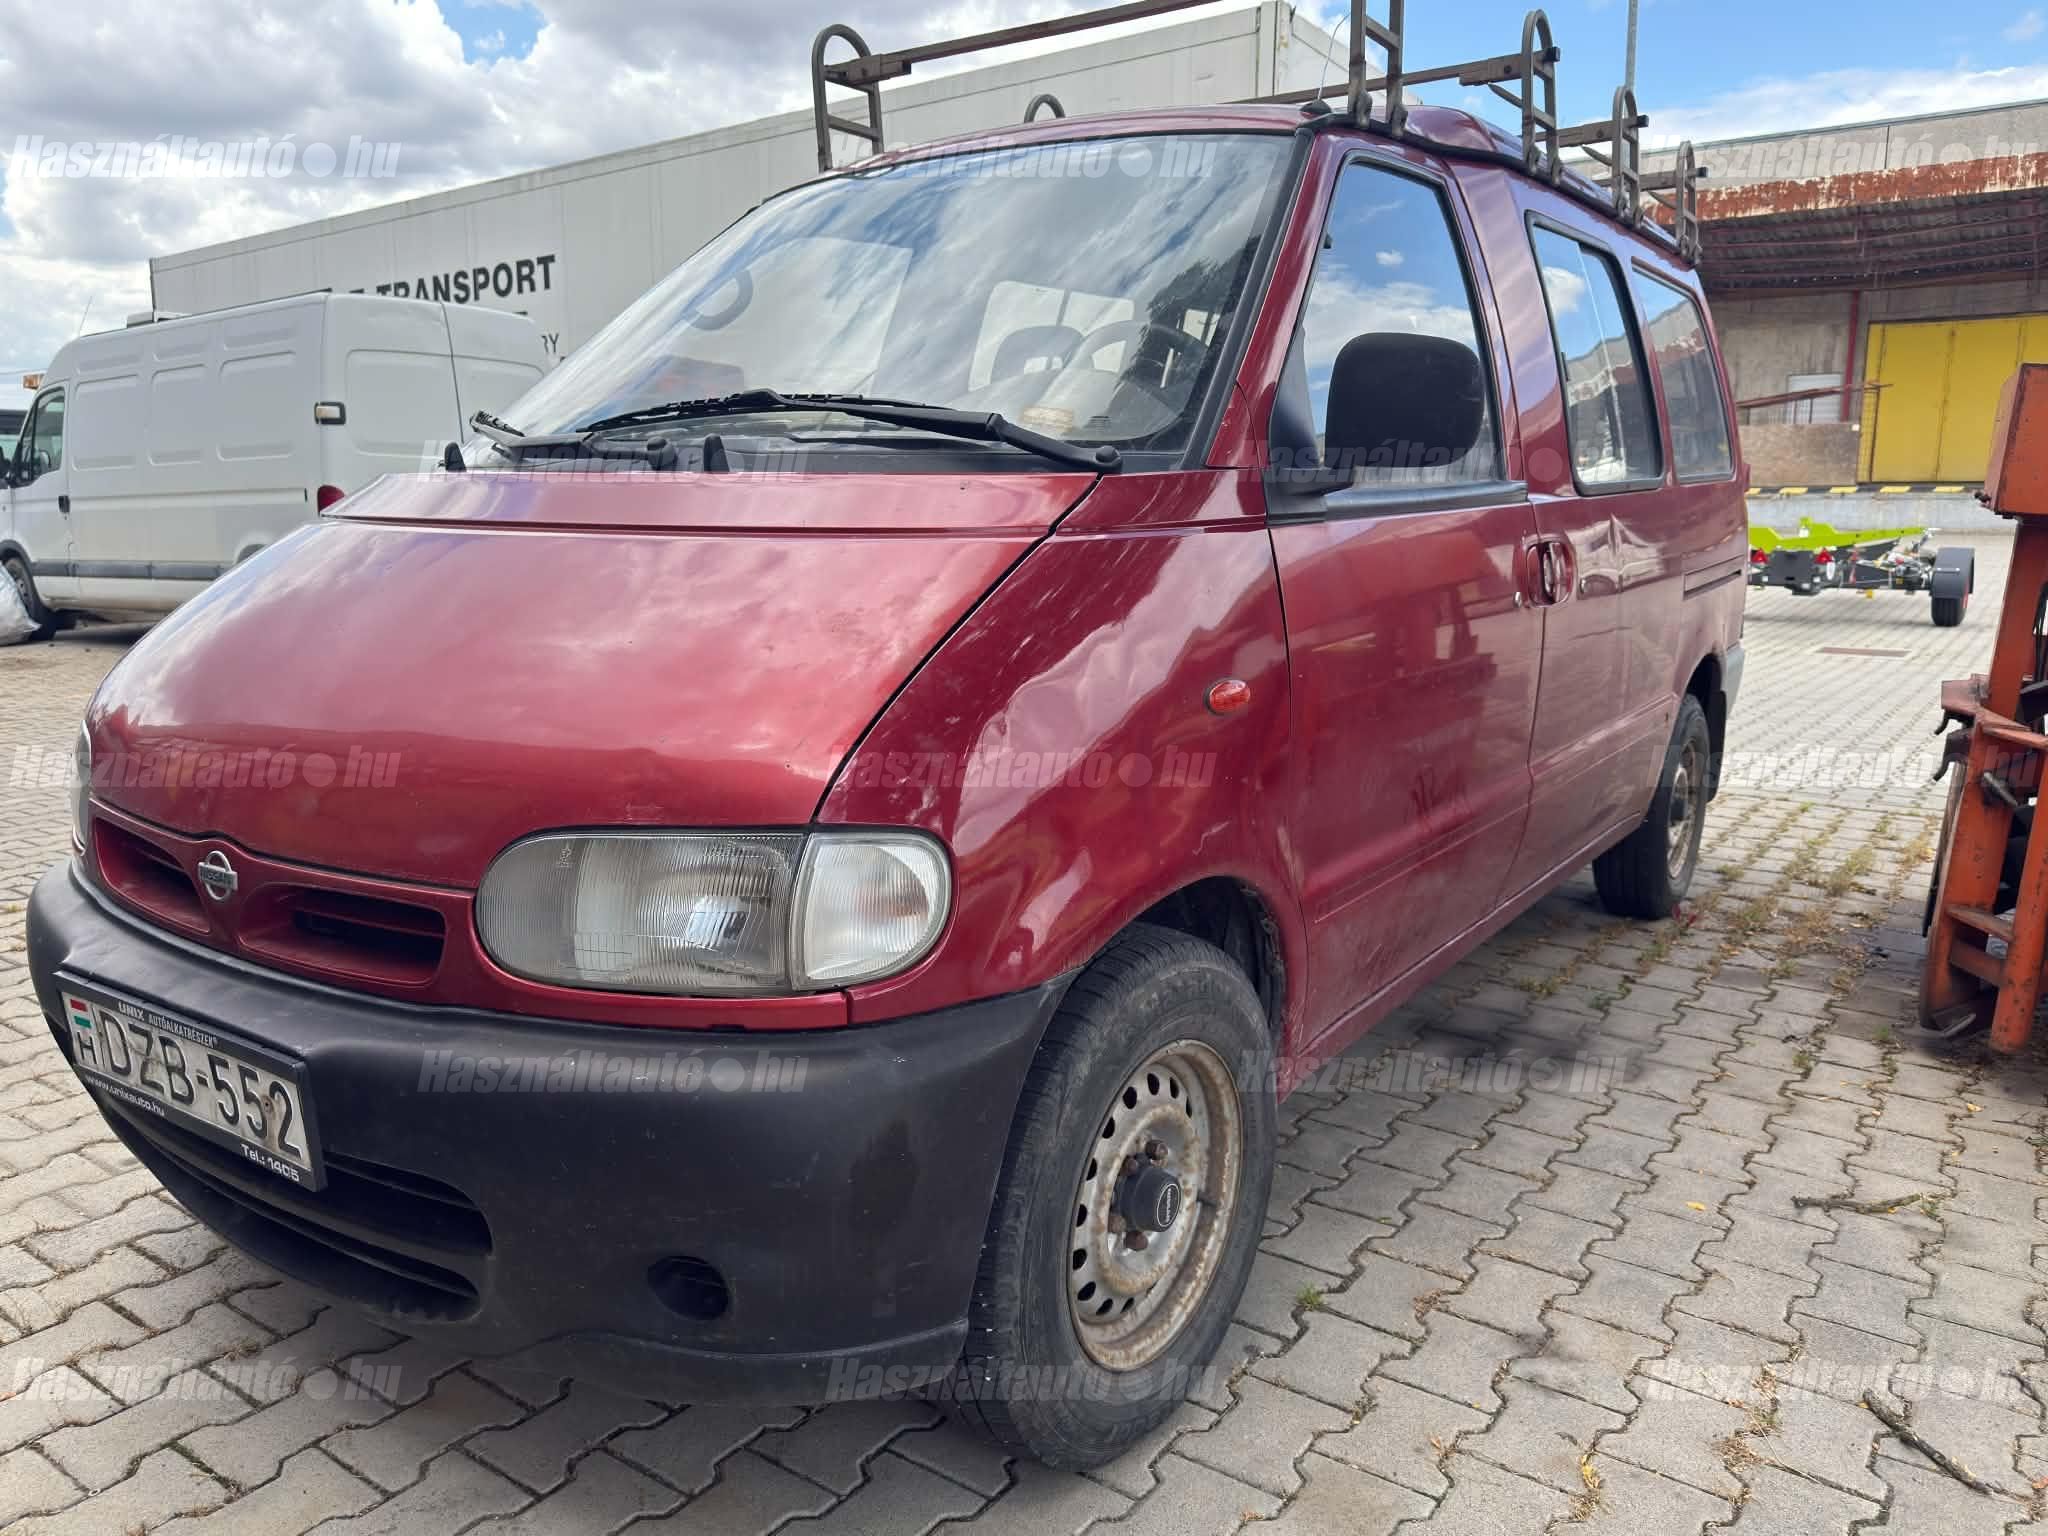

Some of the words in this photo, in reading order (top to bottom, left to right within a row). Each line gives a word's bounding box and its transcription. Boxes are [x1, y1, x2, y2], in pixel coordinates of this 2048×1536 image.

[118, 1001, 145, 1021] UNIX
[77, 1031, 98, 1066] H
[100, 1009, 302, 1161] DZB-552
[267, 1157, 300, 1182] 1405
